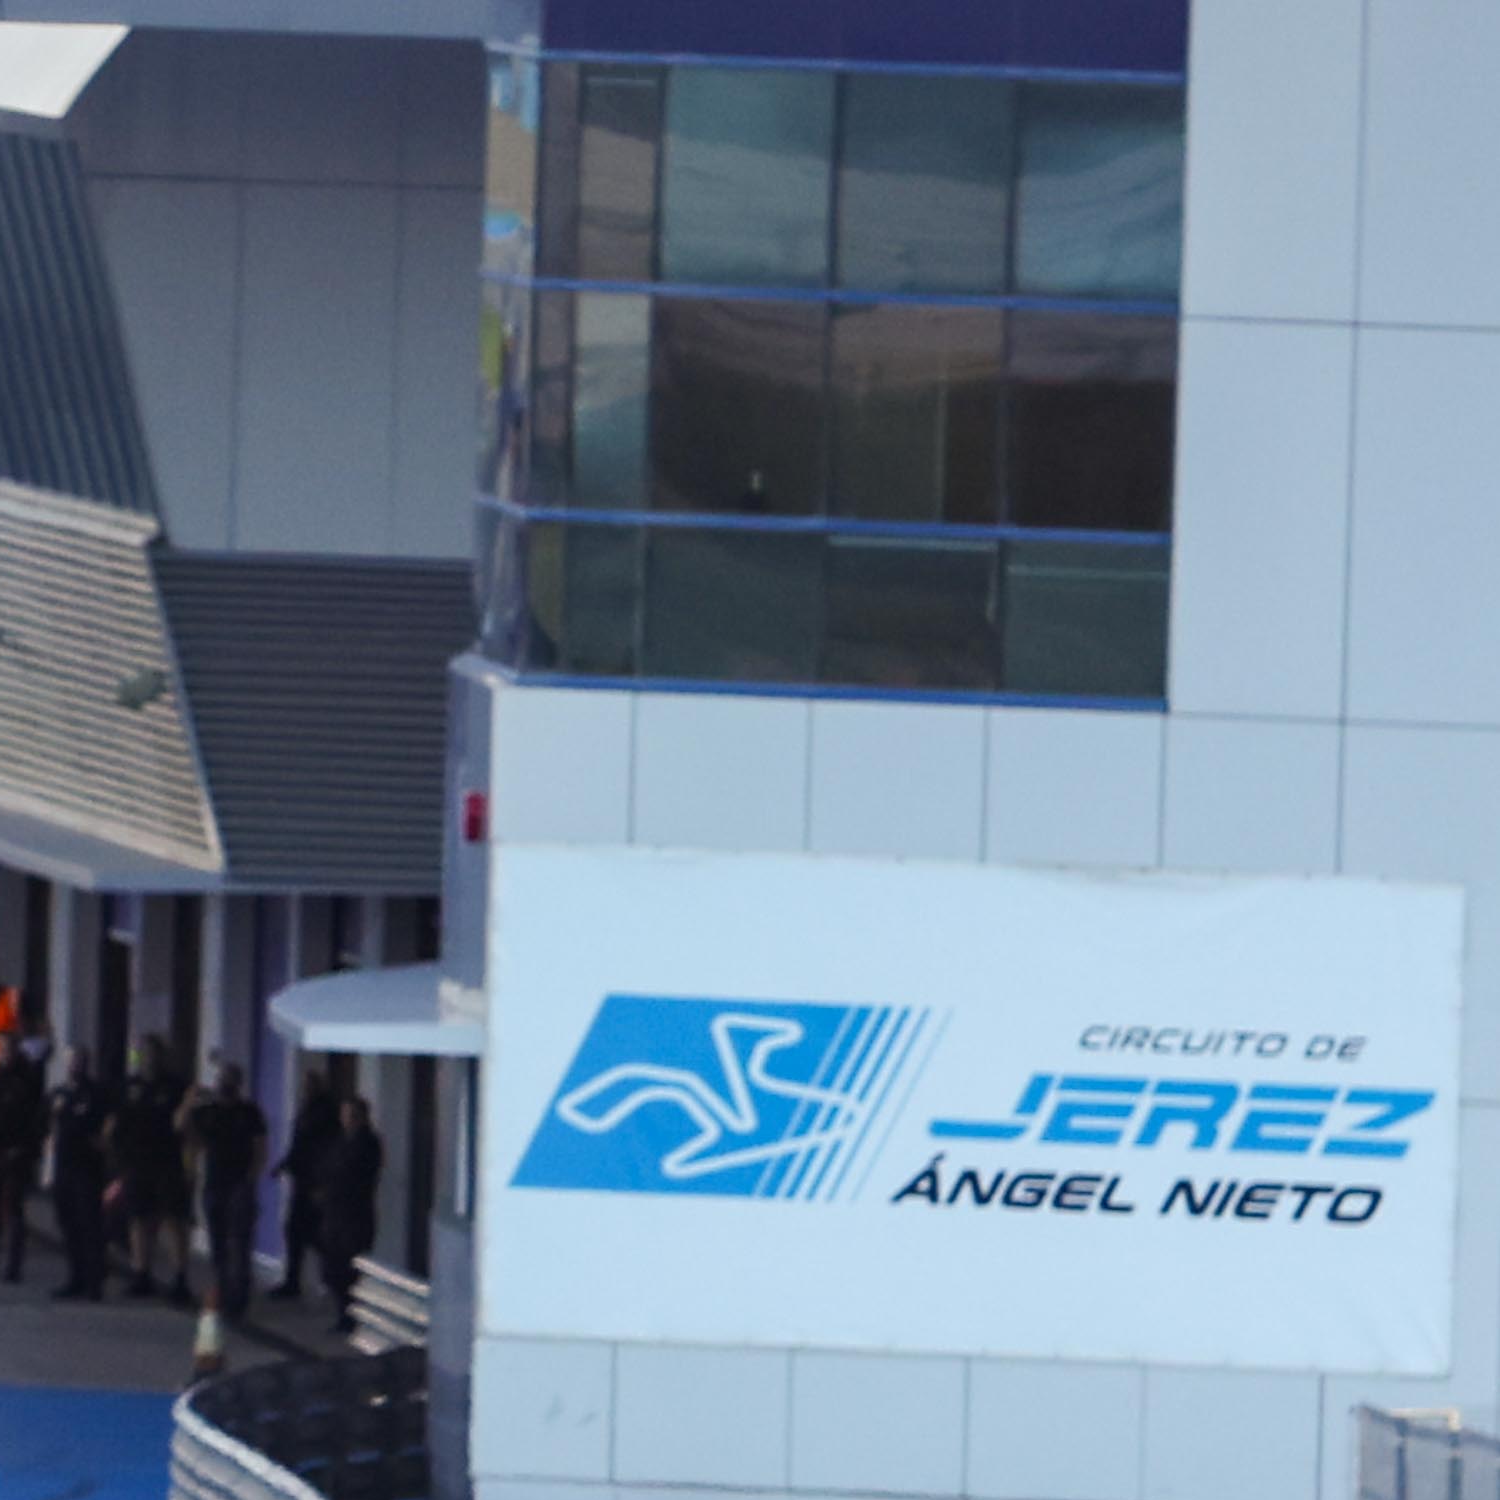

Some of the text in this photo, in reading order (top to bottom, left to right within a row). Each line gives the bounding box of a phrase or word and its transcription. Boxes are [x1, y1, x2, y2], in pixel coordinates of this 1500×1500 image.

[1078, 1023, 1367, 1063] CIRCUITO DE
[928, 1072, 1436, 1160] JEREZ
[890, 1152, 1384, 1224] ÁNGEL NIETO
